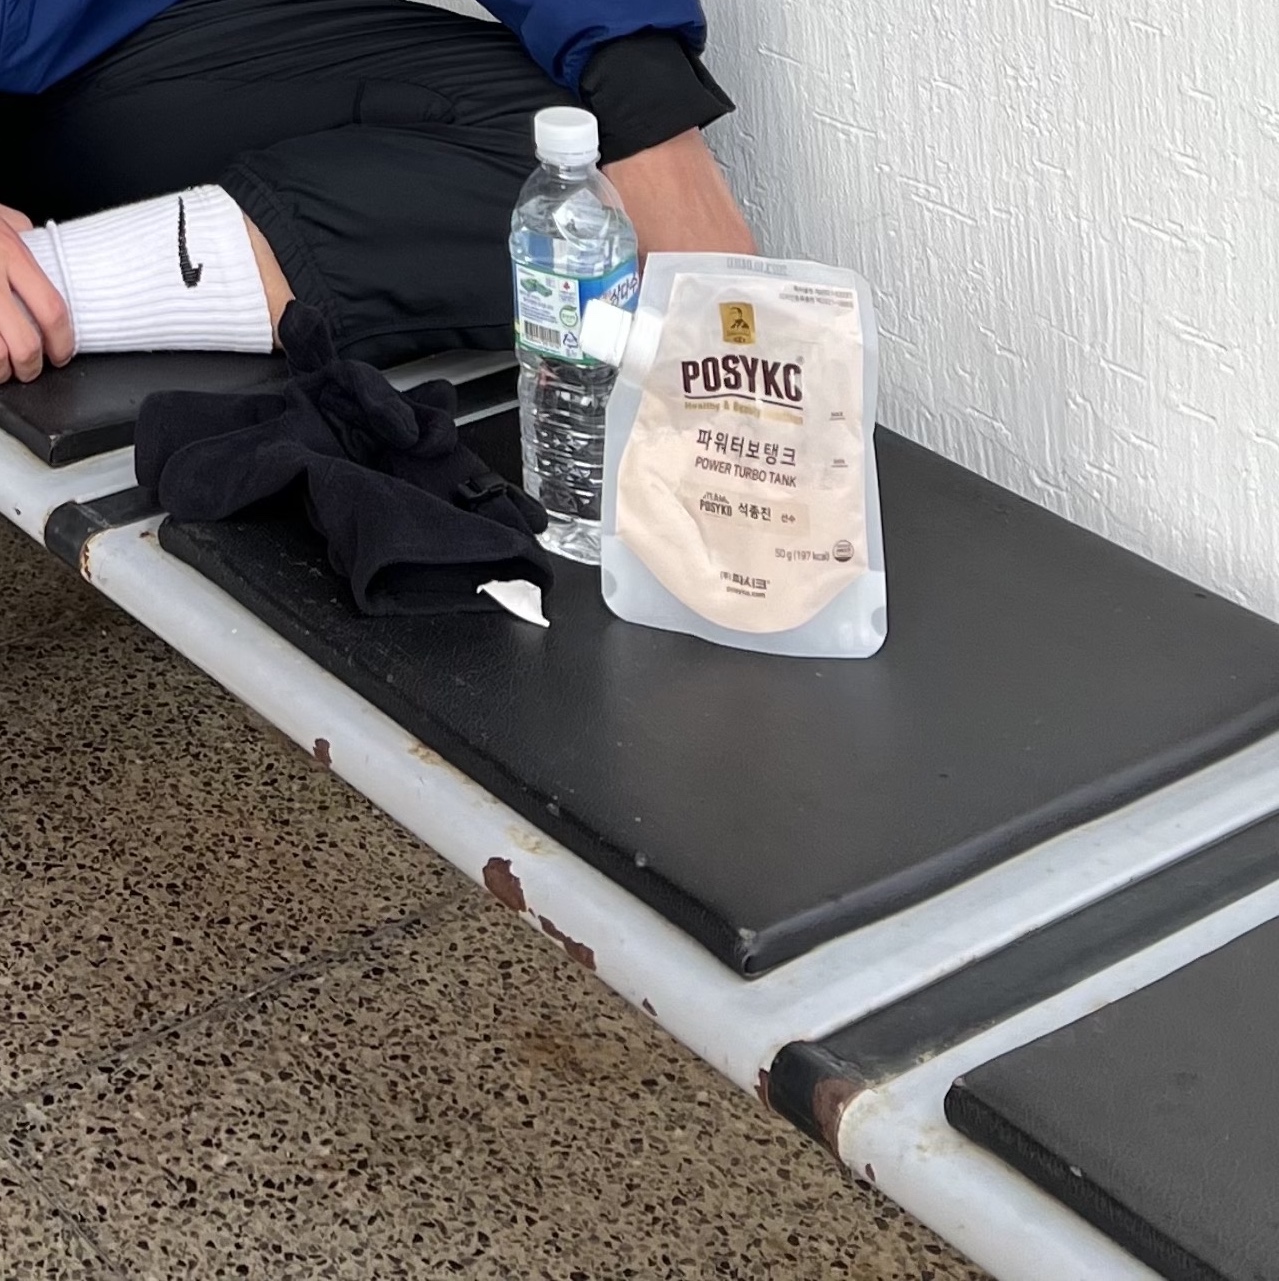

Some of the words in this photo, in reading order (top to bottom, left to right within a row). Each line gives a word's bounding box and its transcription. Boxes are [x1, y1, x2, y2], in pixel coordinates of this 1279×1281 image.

[696, 428, 796, 467] 파워터보탱크
[695, 456, 732, 475] POWER
[733, 464, 767, 482] TURBO
[769, 471, 797, 487] TANK
